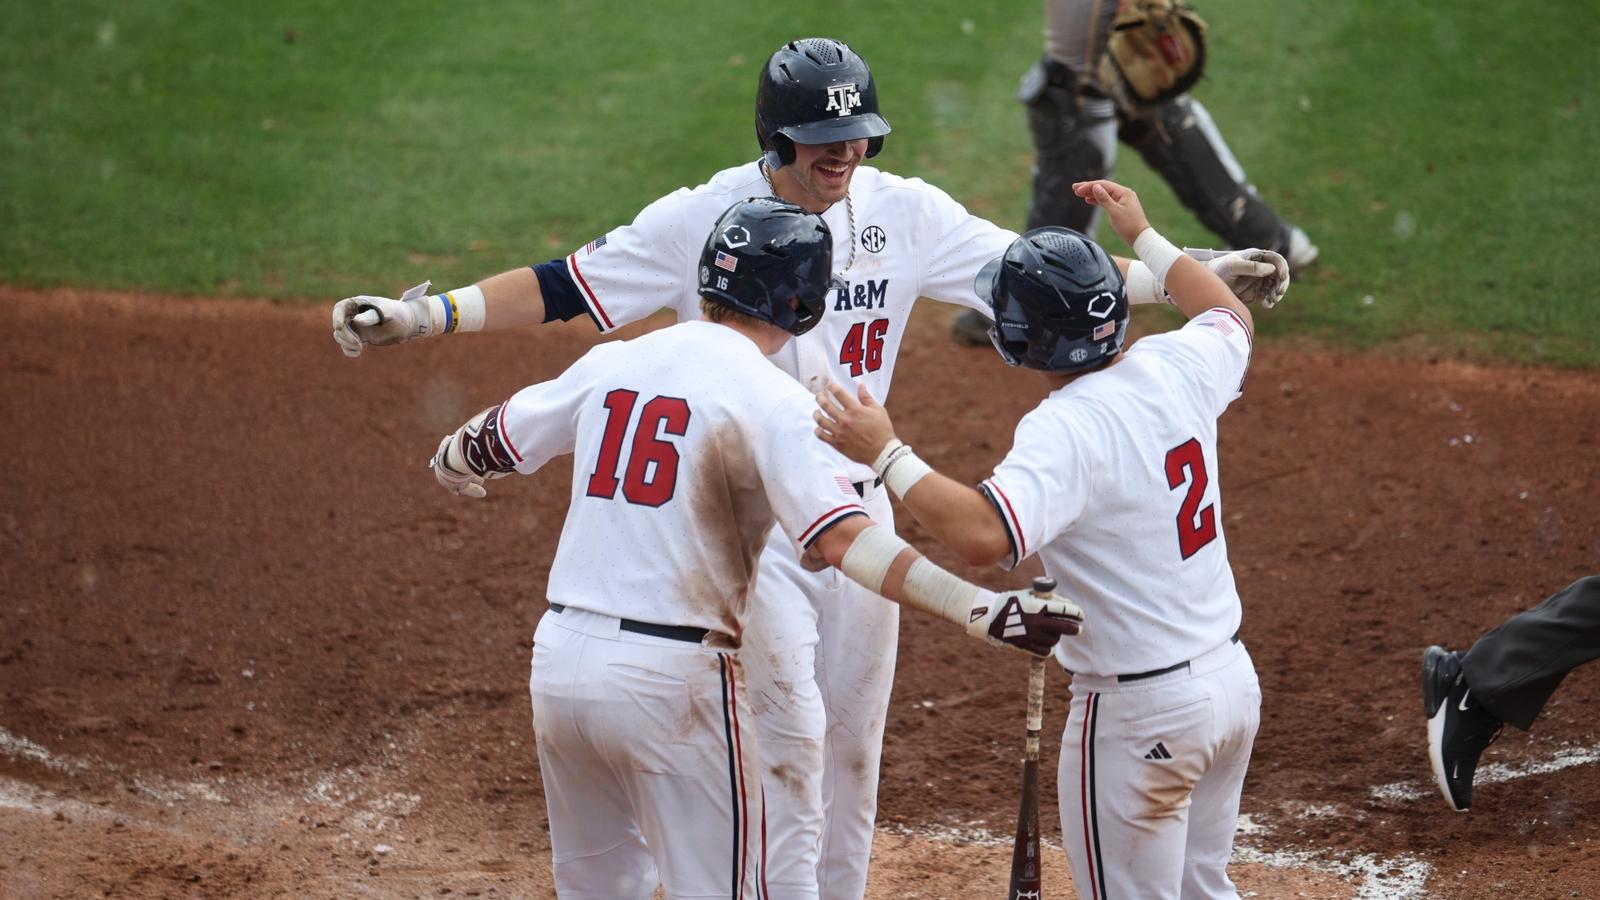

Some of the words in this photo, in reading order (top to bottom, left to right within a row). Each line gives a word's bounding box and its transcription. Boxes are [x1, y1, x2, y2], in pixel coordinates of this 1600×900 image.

[861, 226, 886, 253] SEC
[716, 275, 729, 290] 16
[834, 279, 888, 311] A&M
[839, 318, 889, 378] 46
[1100, 342, 1108, 354] 2
[586, 388, 691, 508] 16
[1164, 437, 1217, 561] 2
